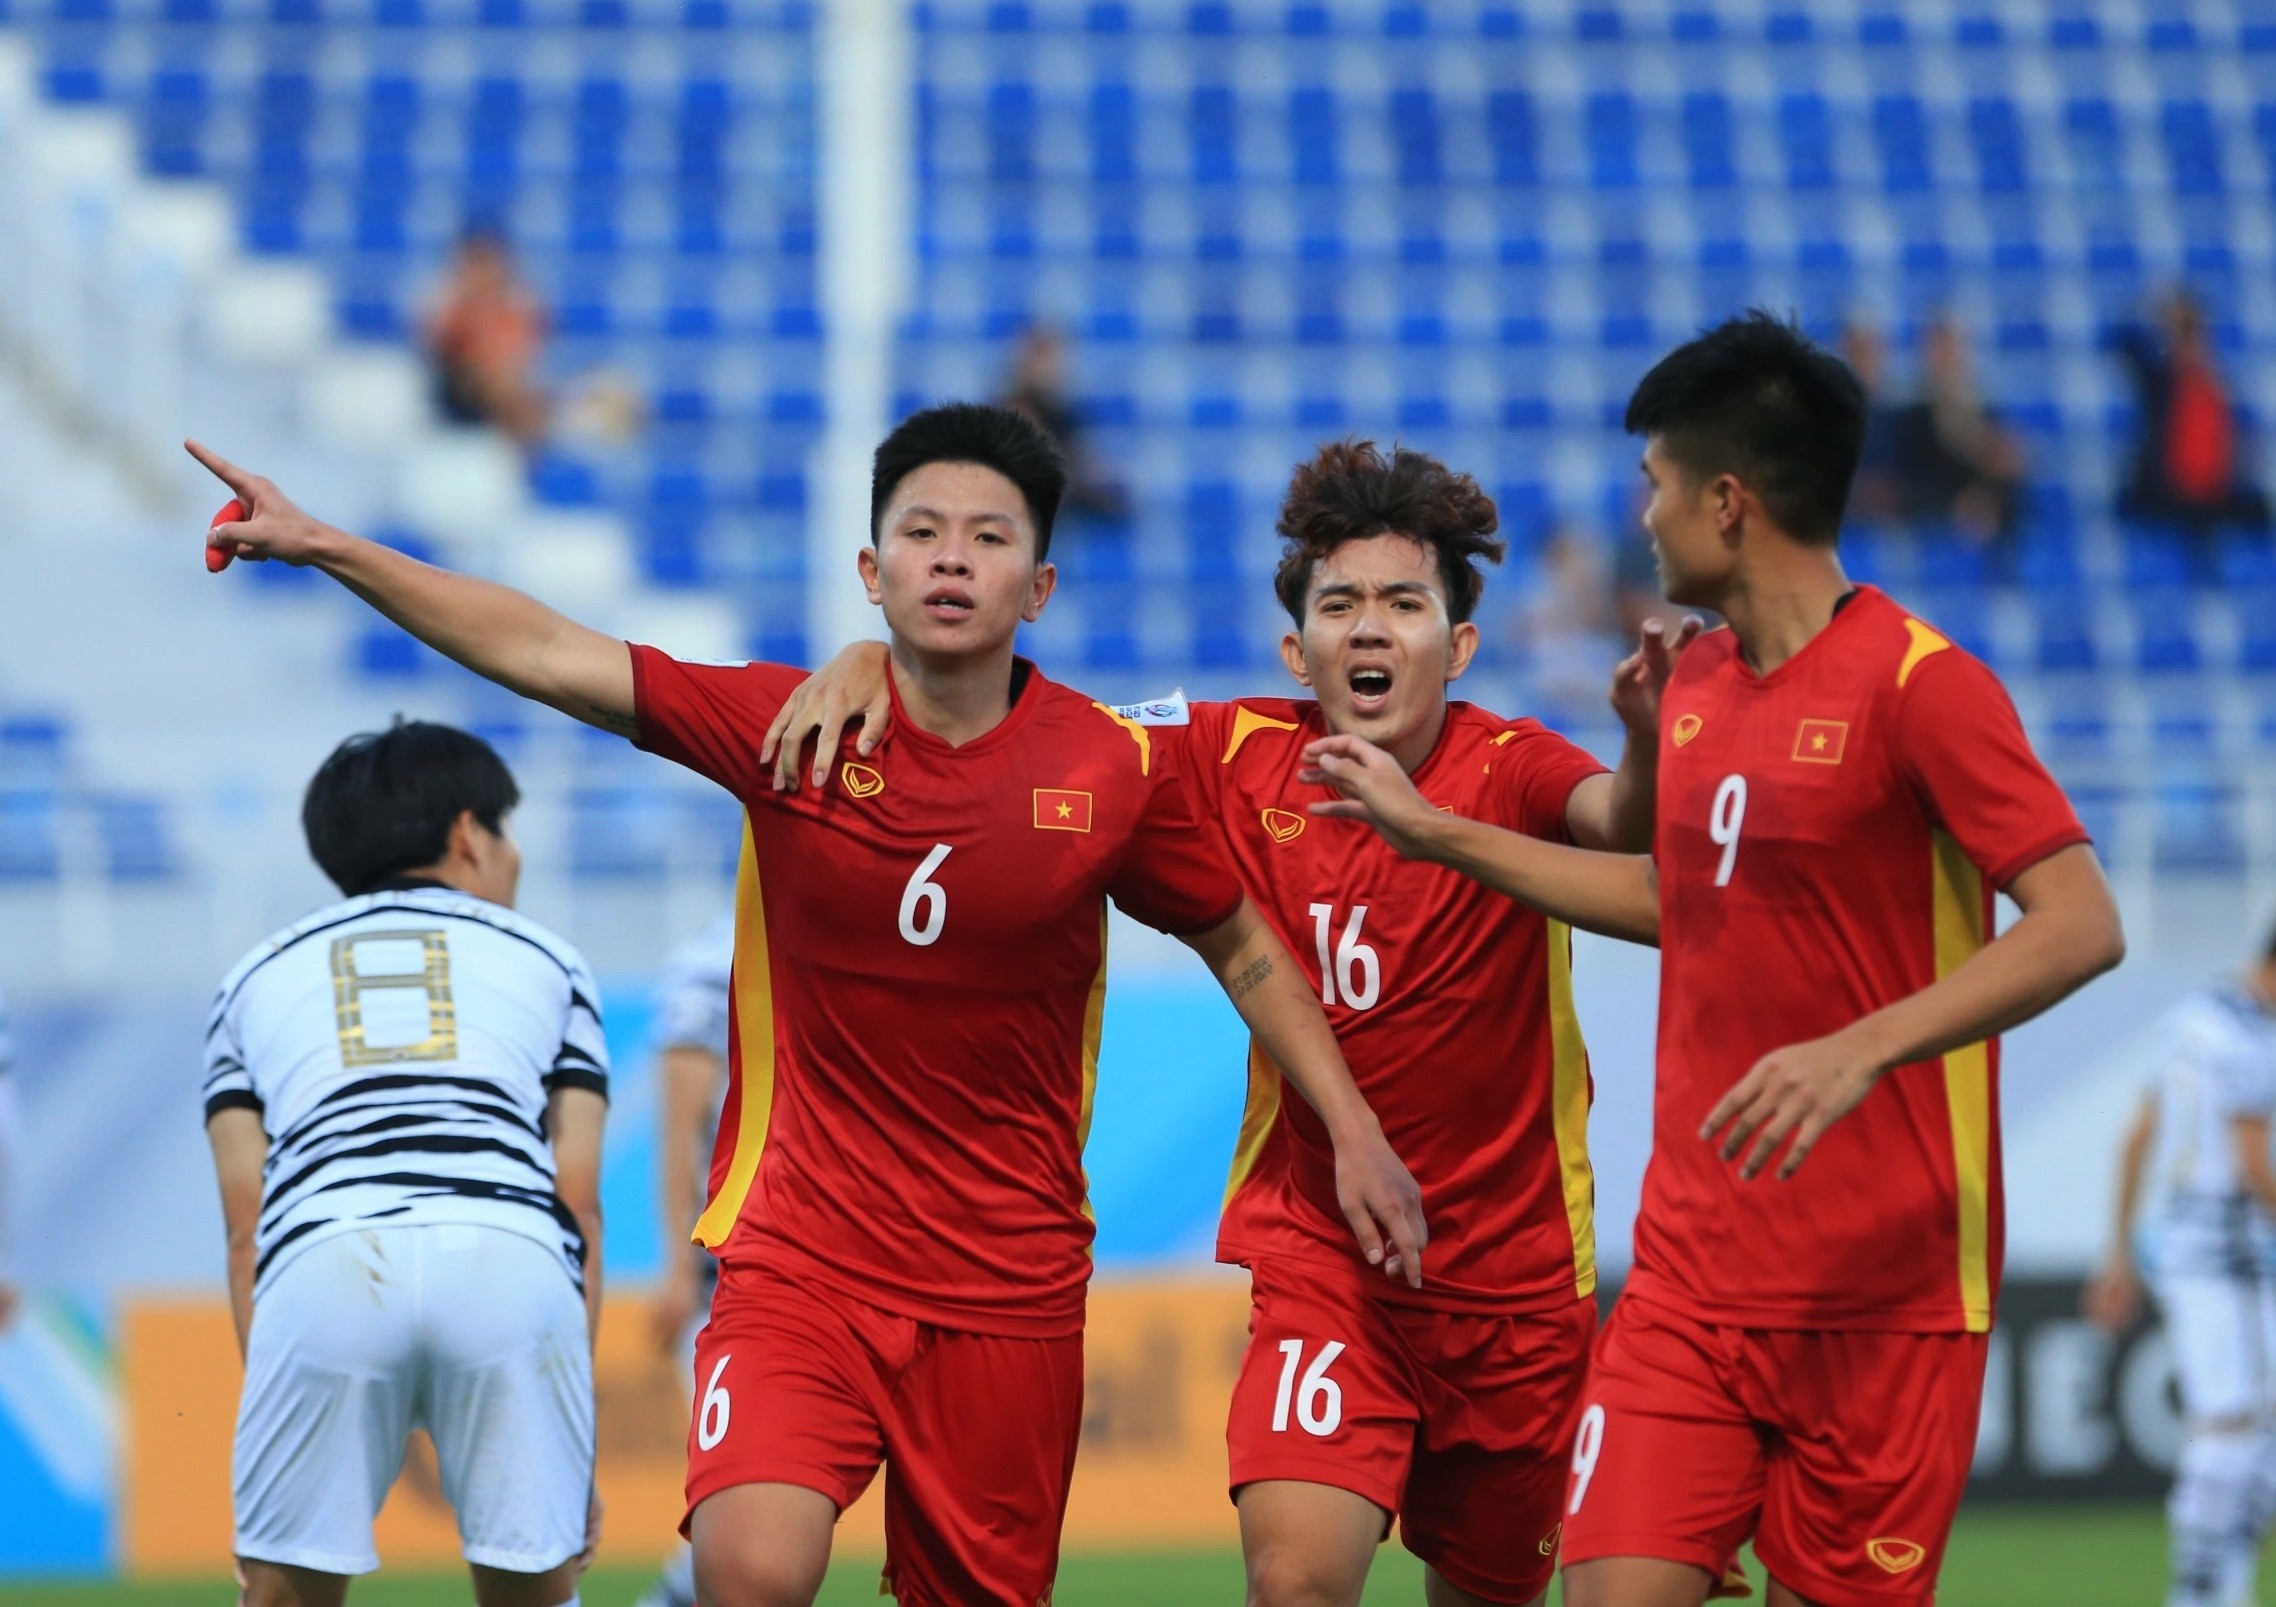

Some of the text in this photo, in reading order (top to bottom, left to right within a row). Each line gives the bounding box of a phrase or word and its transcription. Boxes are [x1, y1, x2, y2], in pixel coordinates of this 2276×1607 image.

[1709, 772, 1747, 887] 9
[897, 842, 953, 946] 6
[330, 929, 457, 1067] 8
[1308, 902, 1381, 1011] 16
[697, 1354, 732, 1452] 6
[1271, 1338, 1347, 1437] 16
[1569, 1403, 1606, 1515] 9
